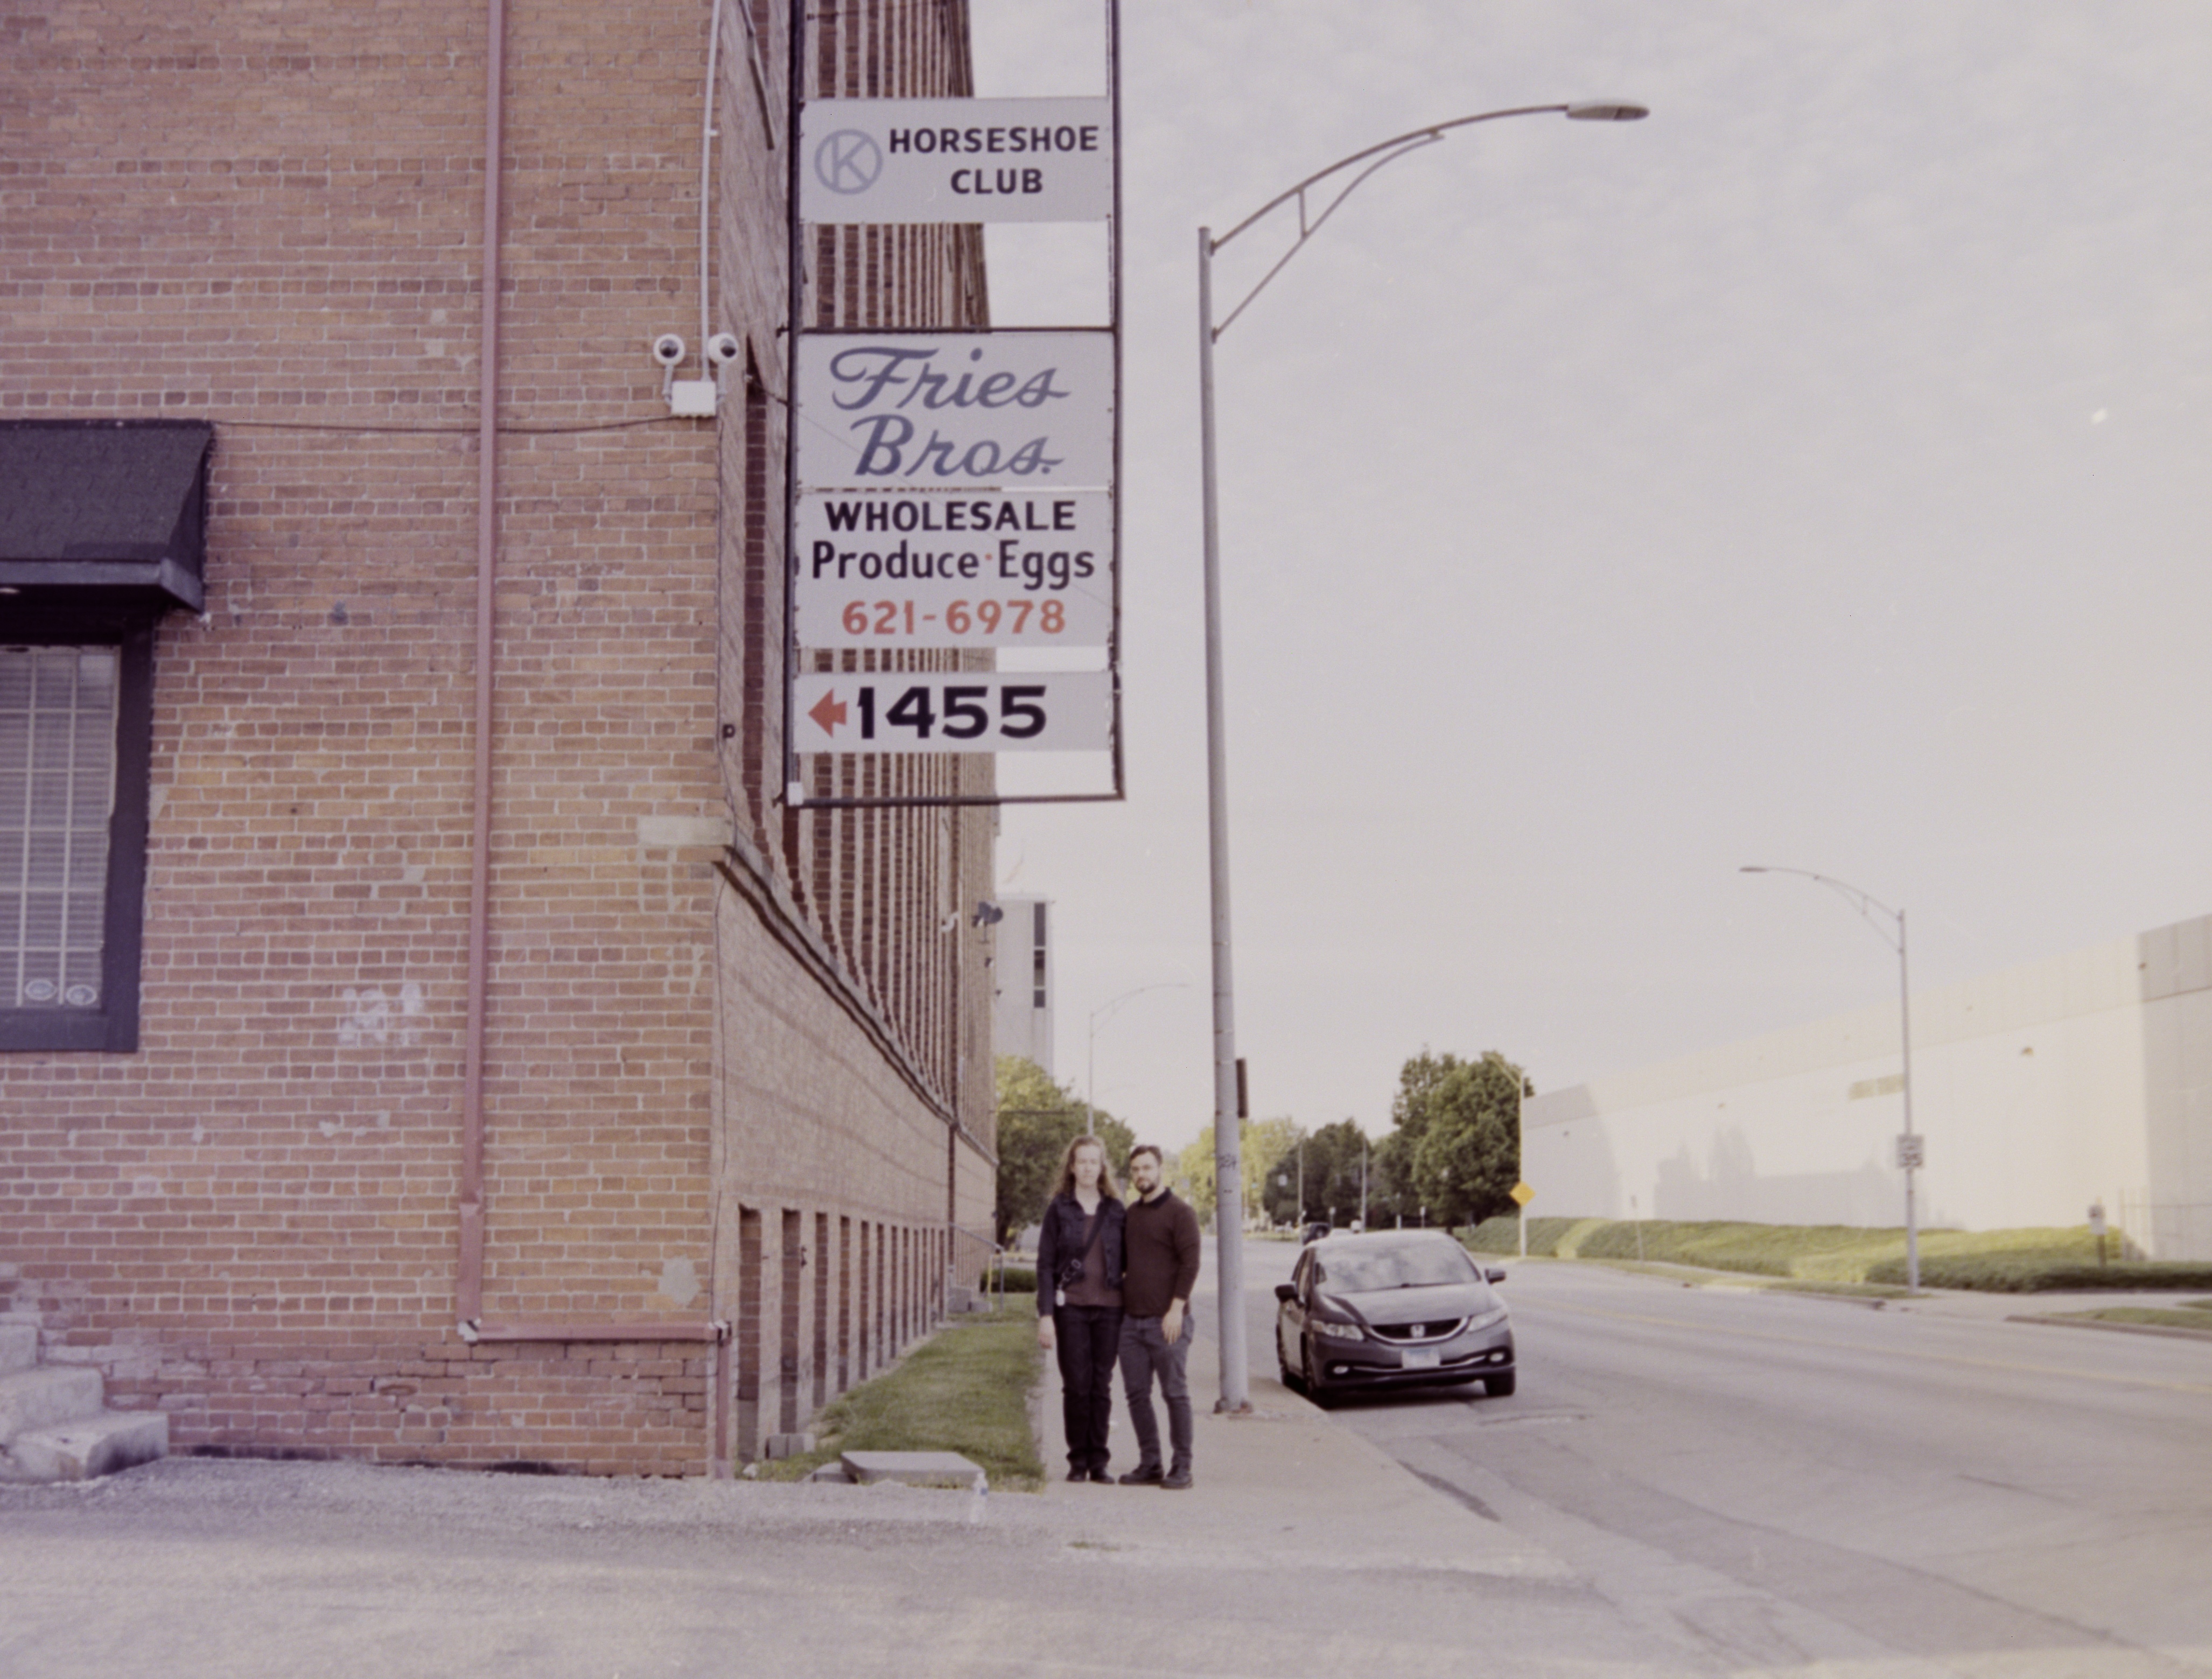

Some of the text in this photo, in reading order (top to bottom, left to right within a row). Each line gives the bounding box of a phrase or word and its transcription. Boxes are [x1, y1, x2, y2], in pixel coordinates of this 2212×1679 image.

[828, 130, 877, 194] K
[890, 126, 1099, 153] HORSESHOE
[950, 169, 1043, 194] CLUB
[829, 346, 1071, 410] Fries
[850, 414, 1066, 477] Bros.
[824, 501, 1076, 531] WHOLESALE
[813, 540, 1095, 591] Produce Eggs
[842, 599, 1066, 635] 621-6978
[857, 686, 1047, 739] 1455
